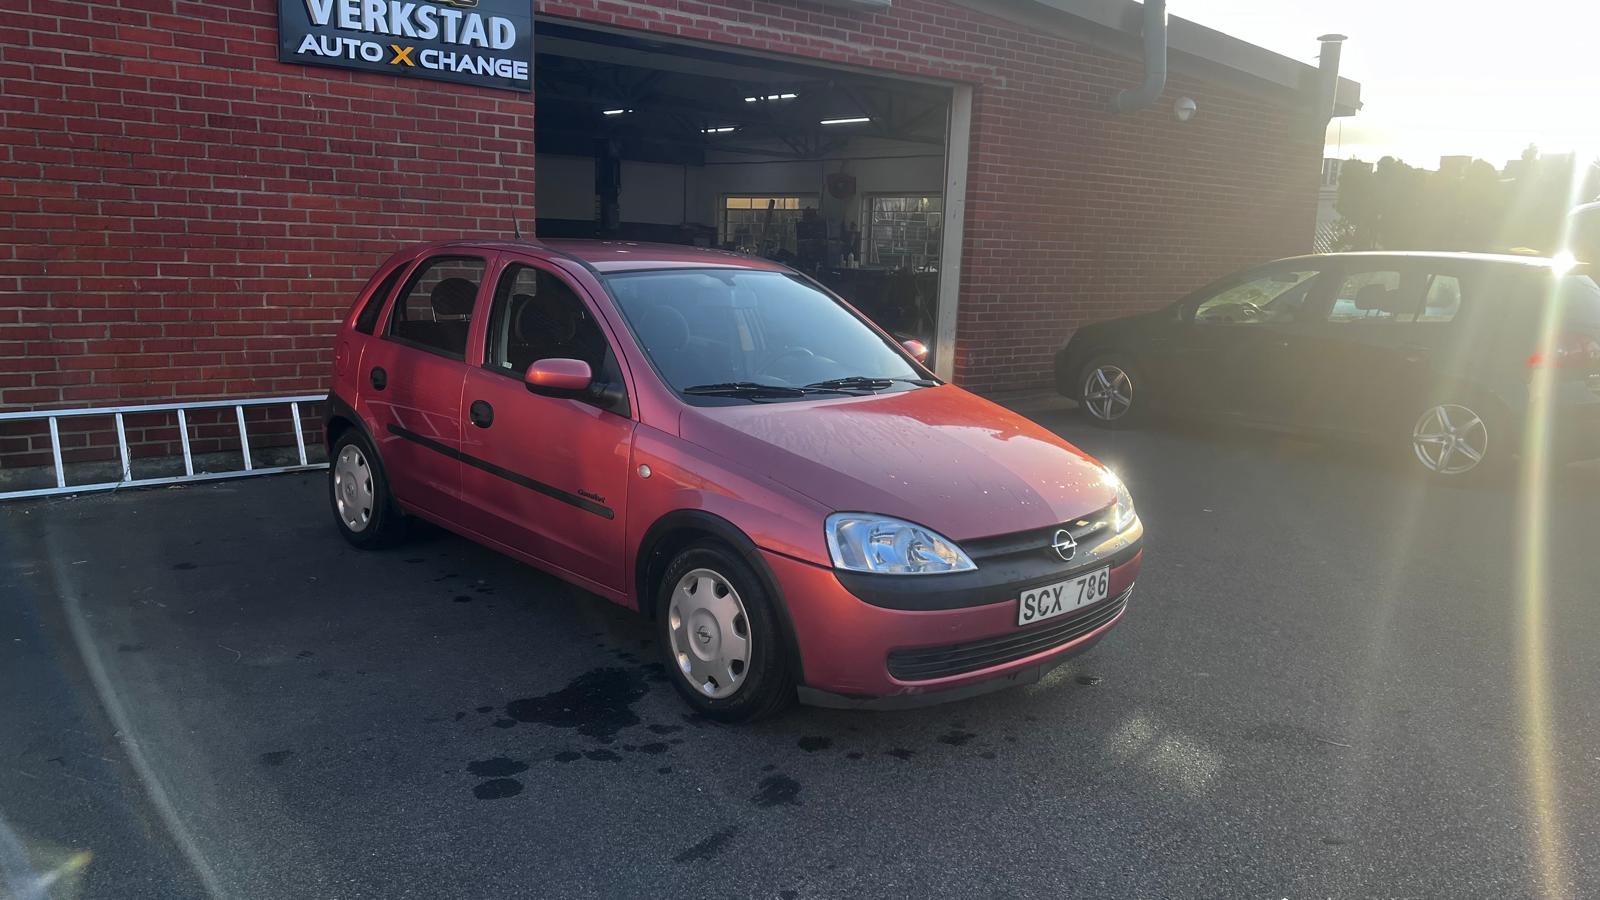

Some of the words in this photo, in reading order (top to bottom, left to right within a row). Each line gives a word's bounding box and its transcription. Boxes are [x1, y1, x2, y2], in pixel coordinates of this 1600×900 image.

[306, 0, 516, 50] VERKSTAD
[298, 34, 383, 62] AUTO
[390, 45, 415, 66] X
[420, 49, 528, 80] CHANGE
[1023, 585, 1063, 621] SCX
[1077, 571, 1107, 605] 786
